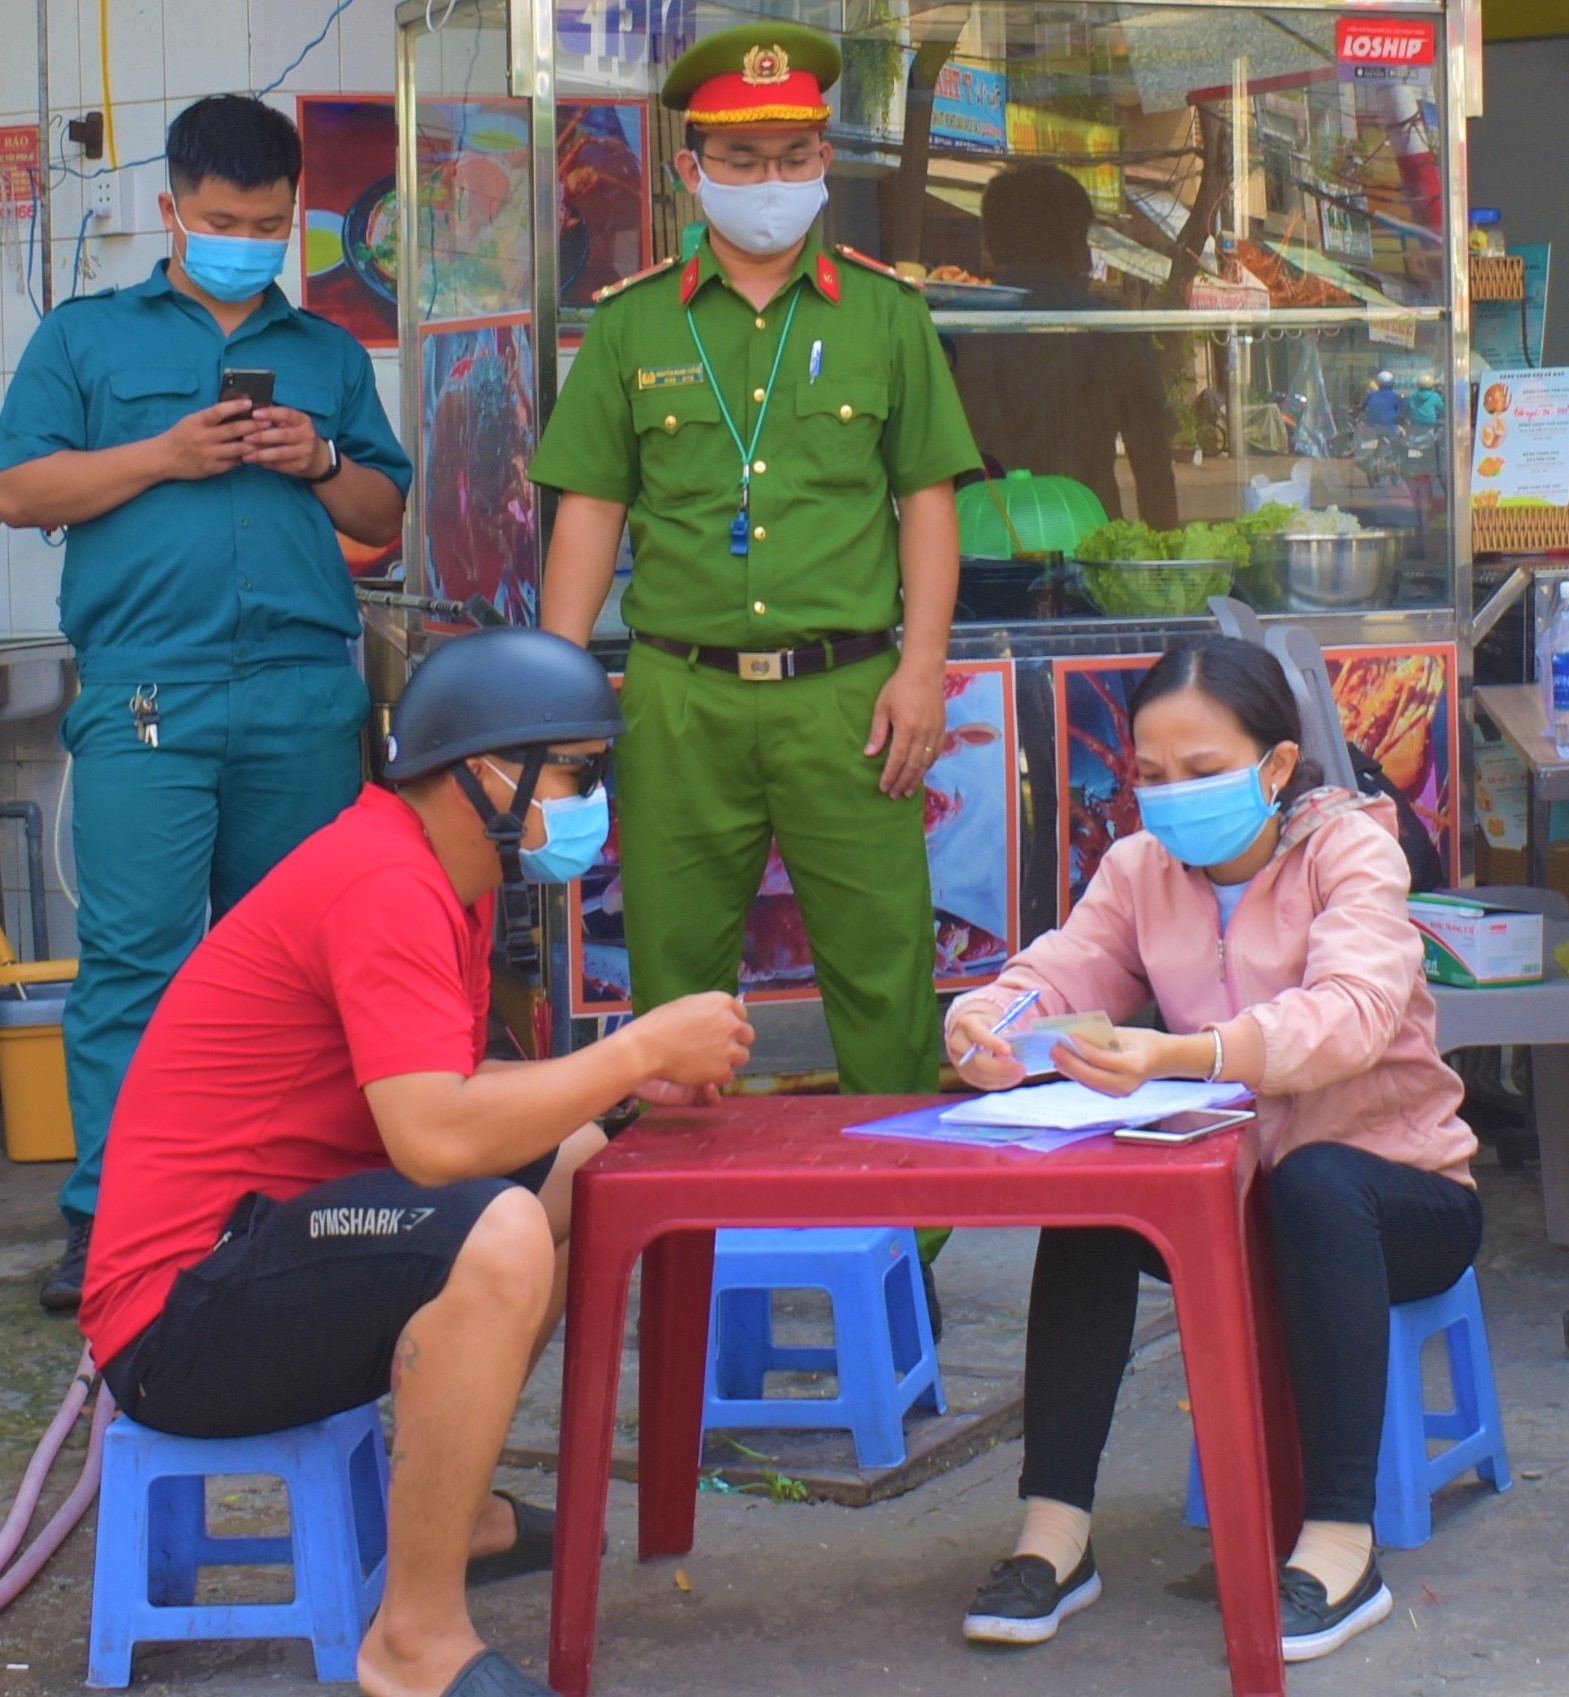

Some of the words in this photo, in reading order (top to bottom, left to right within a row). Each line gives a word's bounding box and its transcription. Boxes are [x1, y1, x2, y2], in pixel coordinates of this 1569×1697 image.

[1343, 35, 1426, 59] LOSHIP
[4, 134, 28, 148] BÁO
[310, 1207, 406, 1238] GYMSHARK
